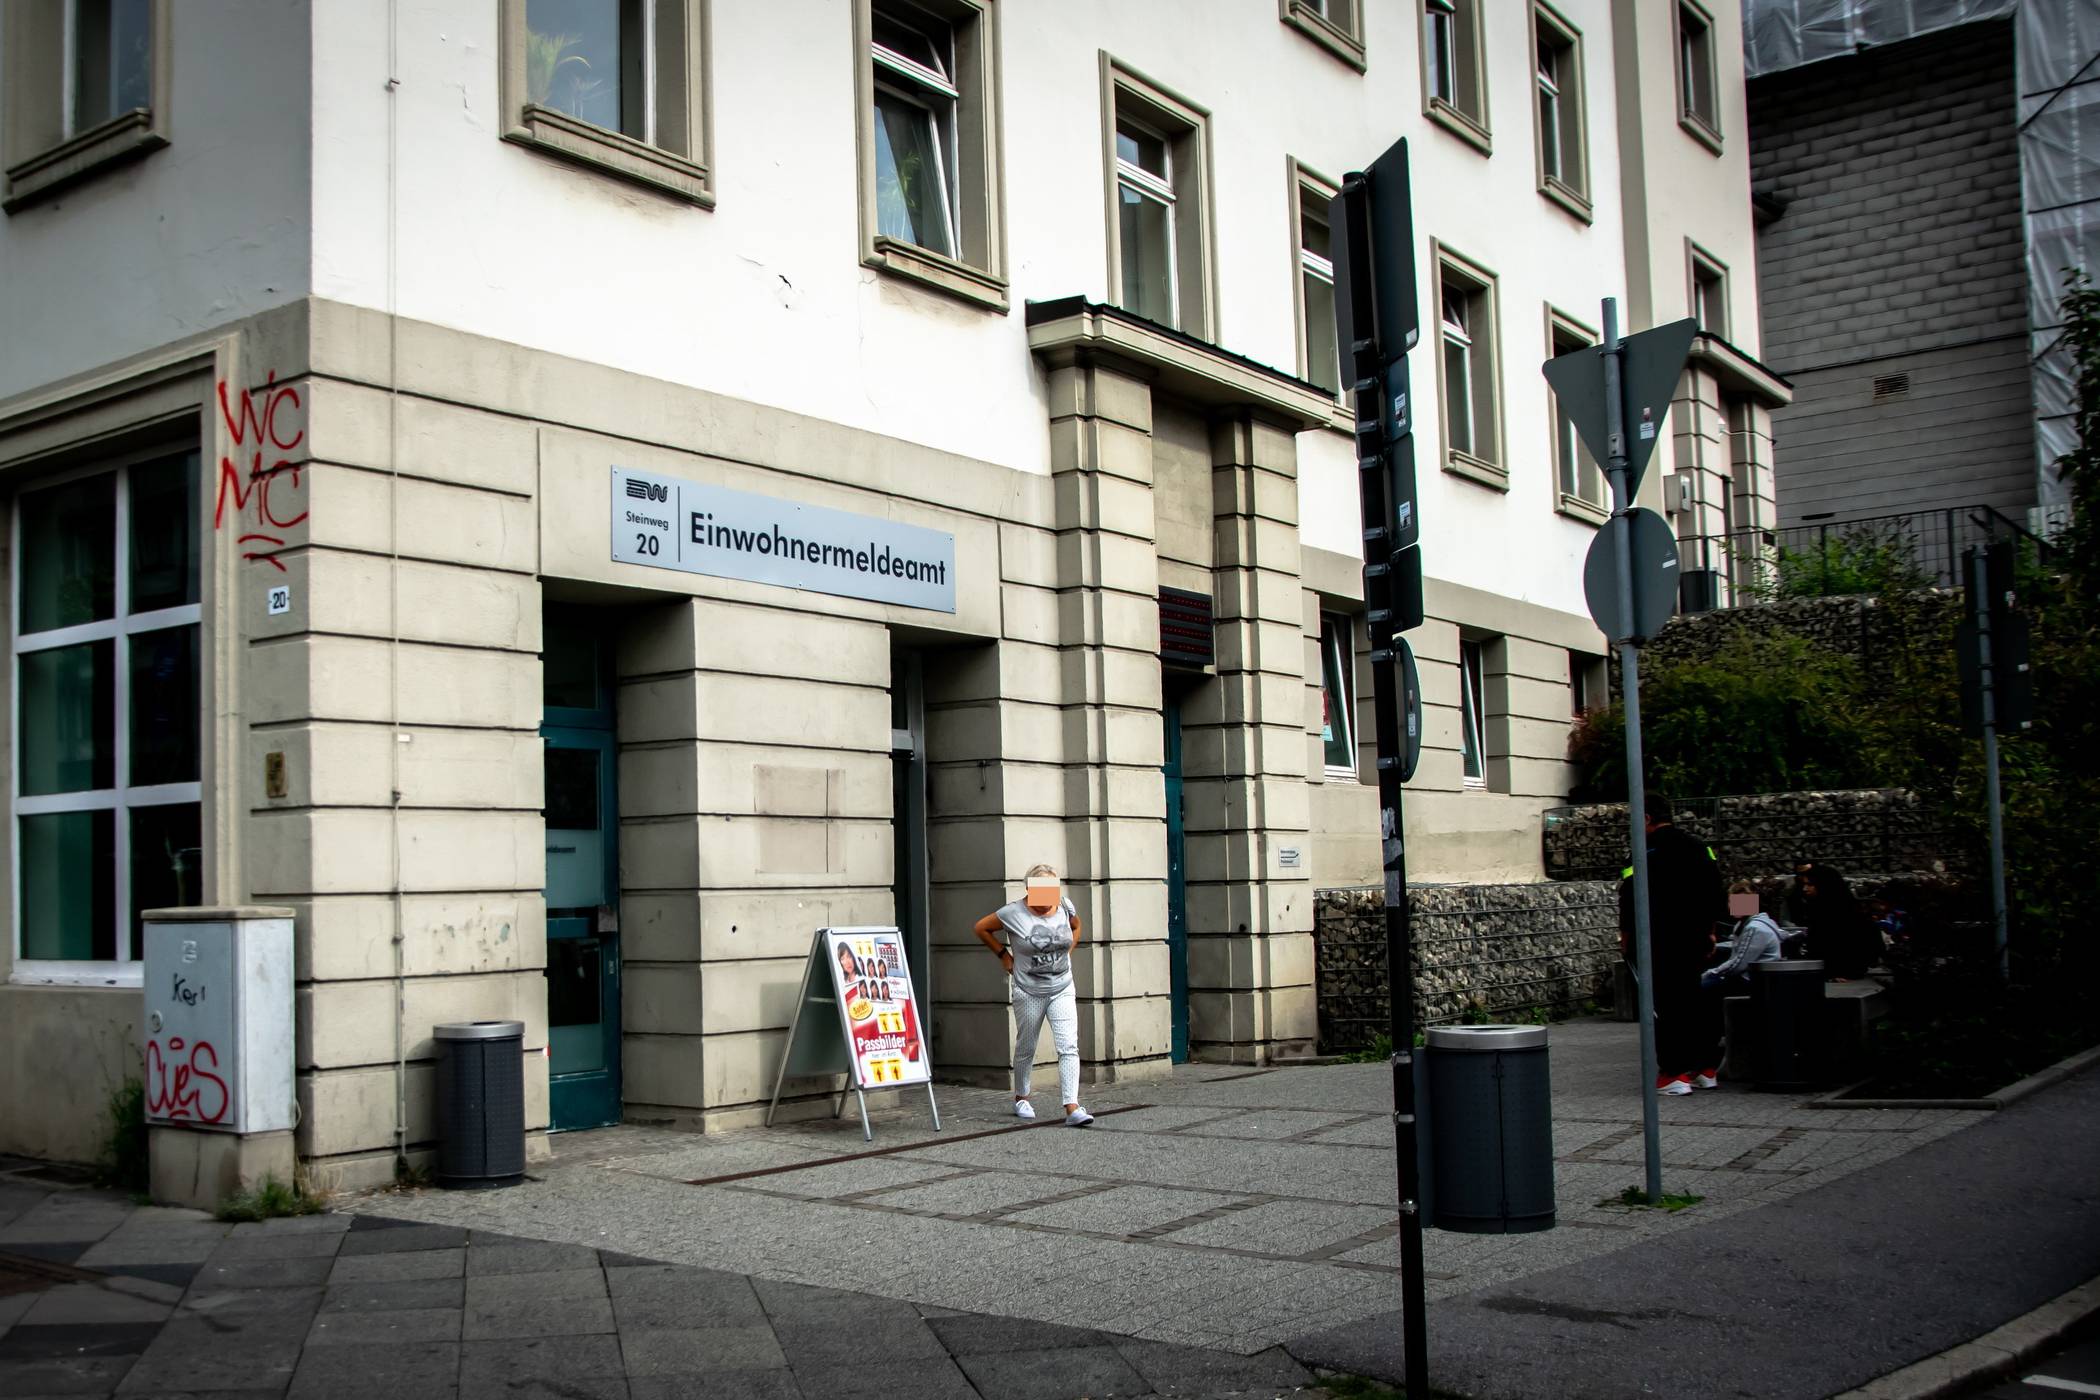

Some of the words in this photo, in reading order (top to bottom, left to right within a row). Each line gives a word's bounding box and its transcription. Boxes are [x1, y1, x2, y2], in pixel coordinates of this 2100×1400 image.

[625, 510, 669, 531] Steinweg
[636, 533, 660, 557] 20
[691, 511, 946, 586] Einwohnermeldeamt
[272, 590, 287, 610] 20
[856, 1033, 906, 1052] Passbilder
